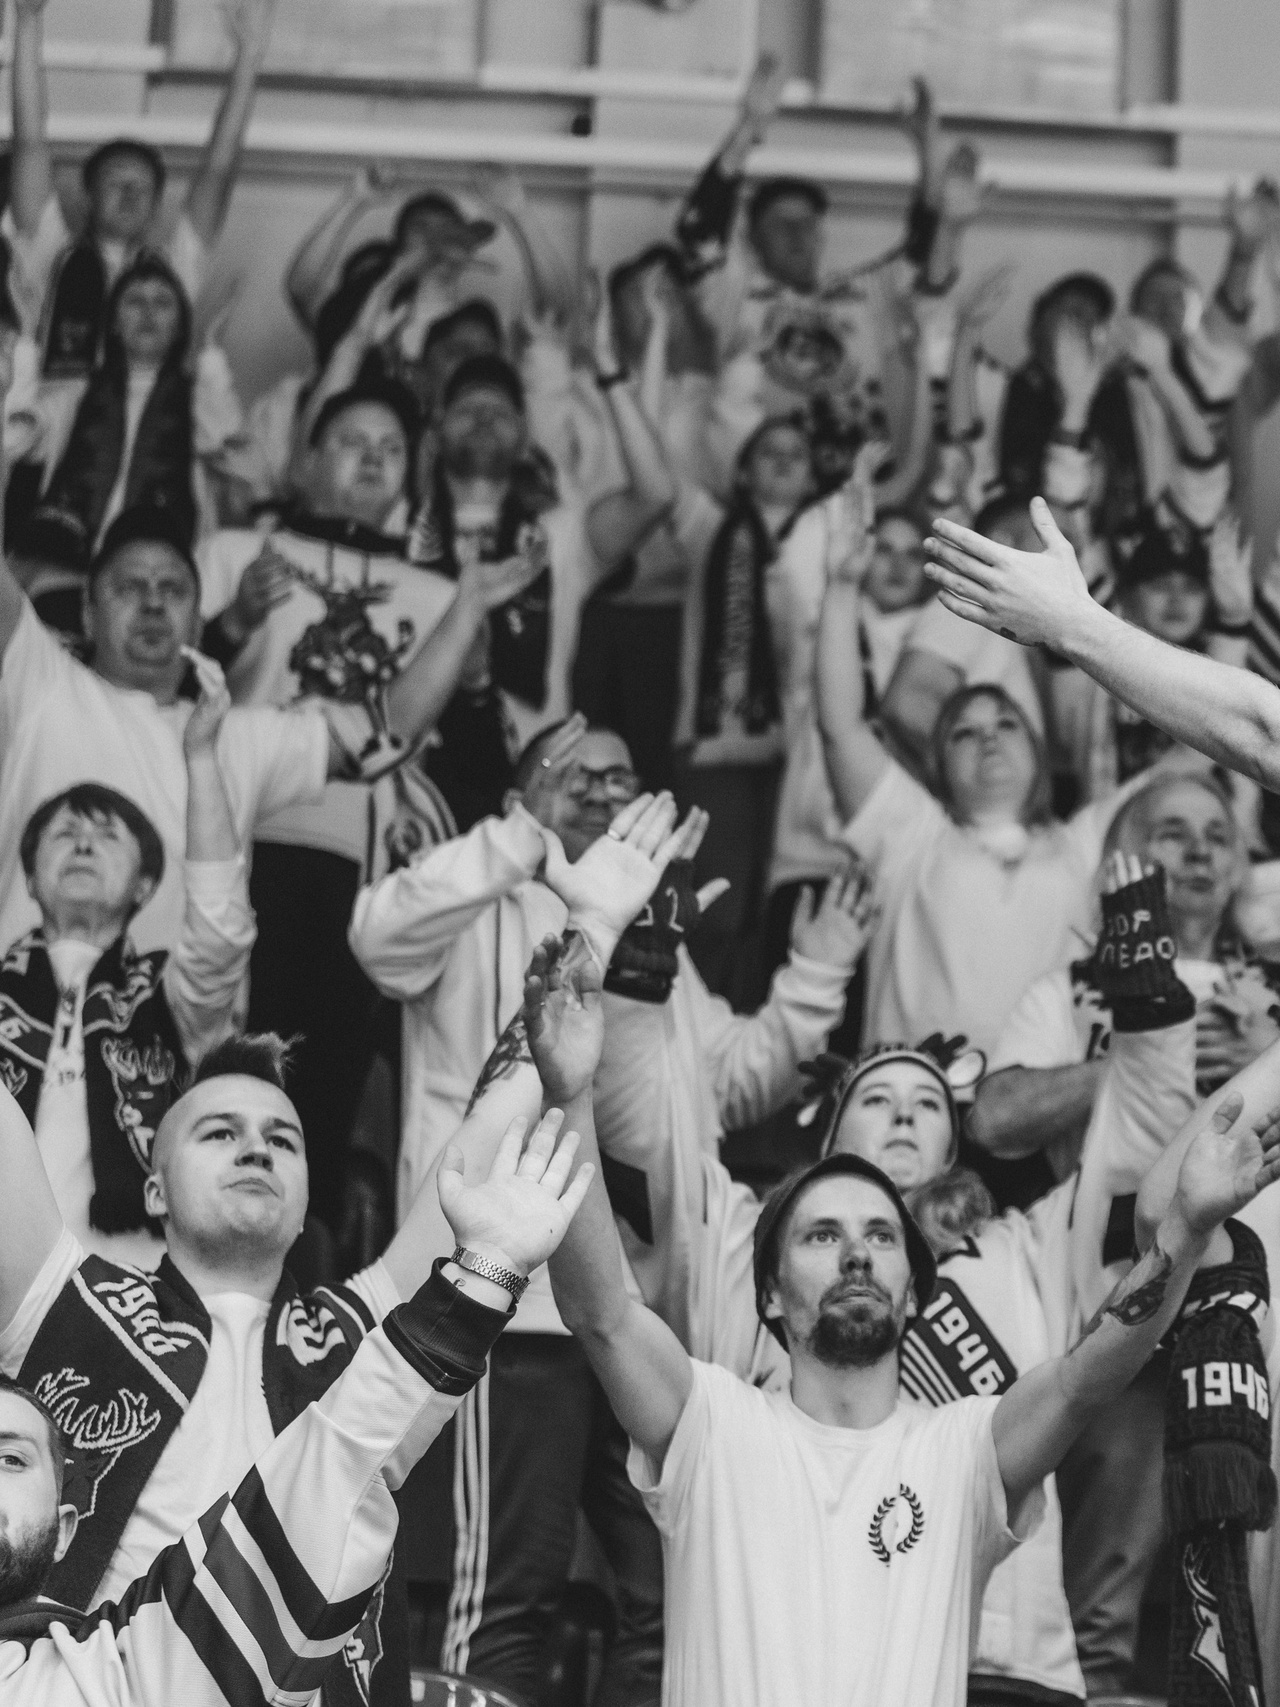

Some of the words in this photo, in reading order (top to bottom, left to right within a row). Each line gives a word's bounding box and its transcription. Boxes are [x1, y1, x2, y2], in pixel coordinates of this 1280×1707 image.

[93, 1277, 192, 1356] 1946
[922, 1291, 1005, 1395] 1946
[1181, 1361, 1269, 1421] 1946
